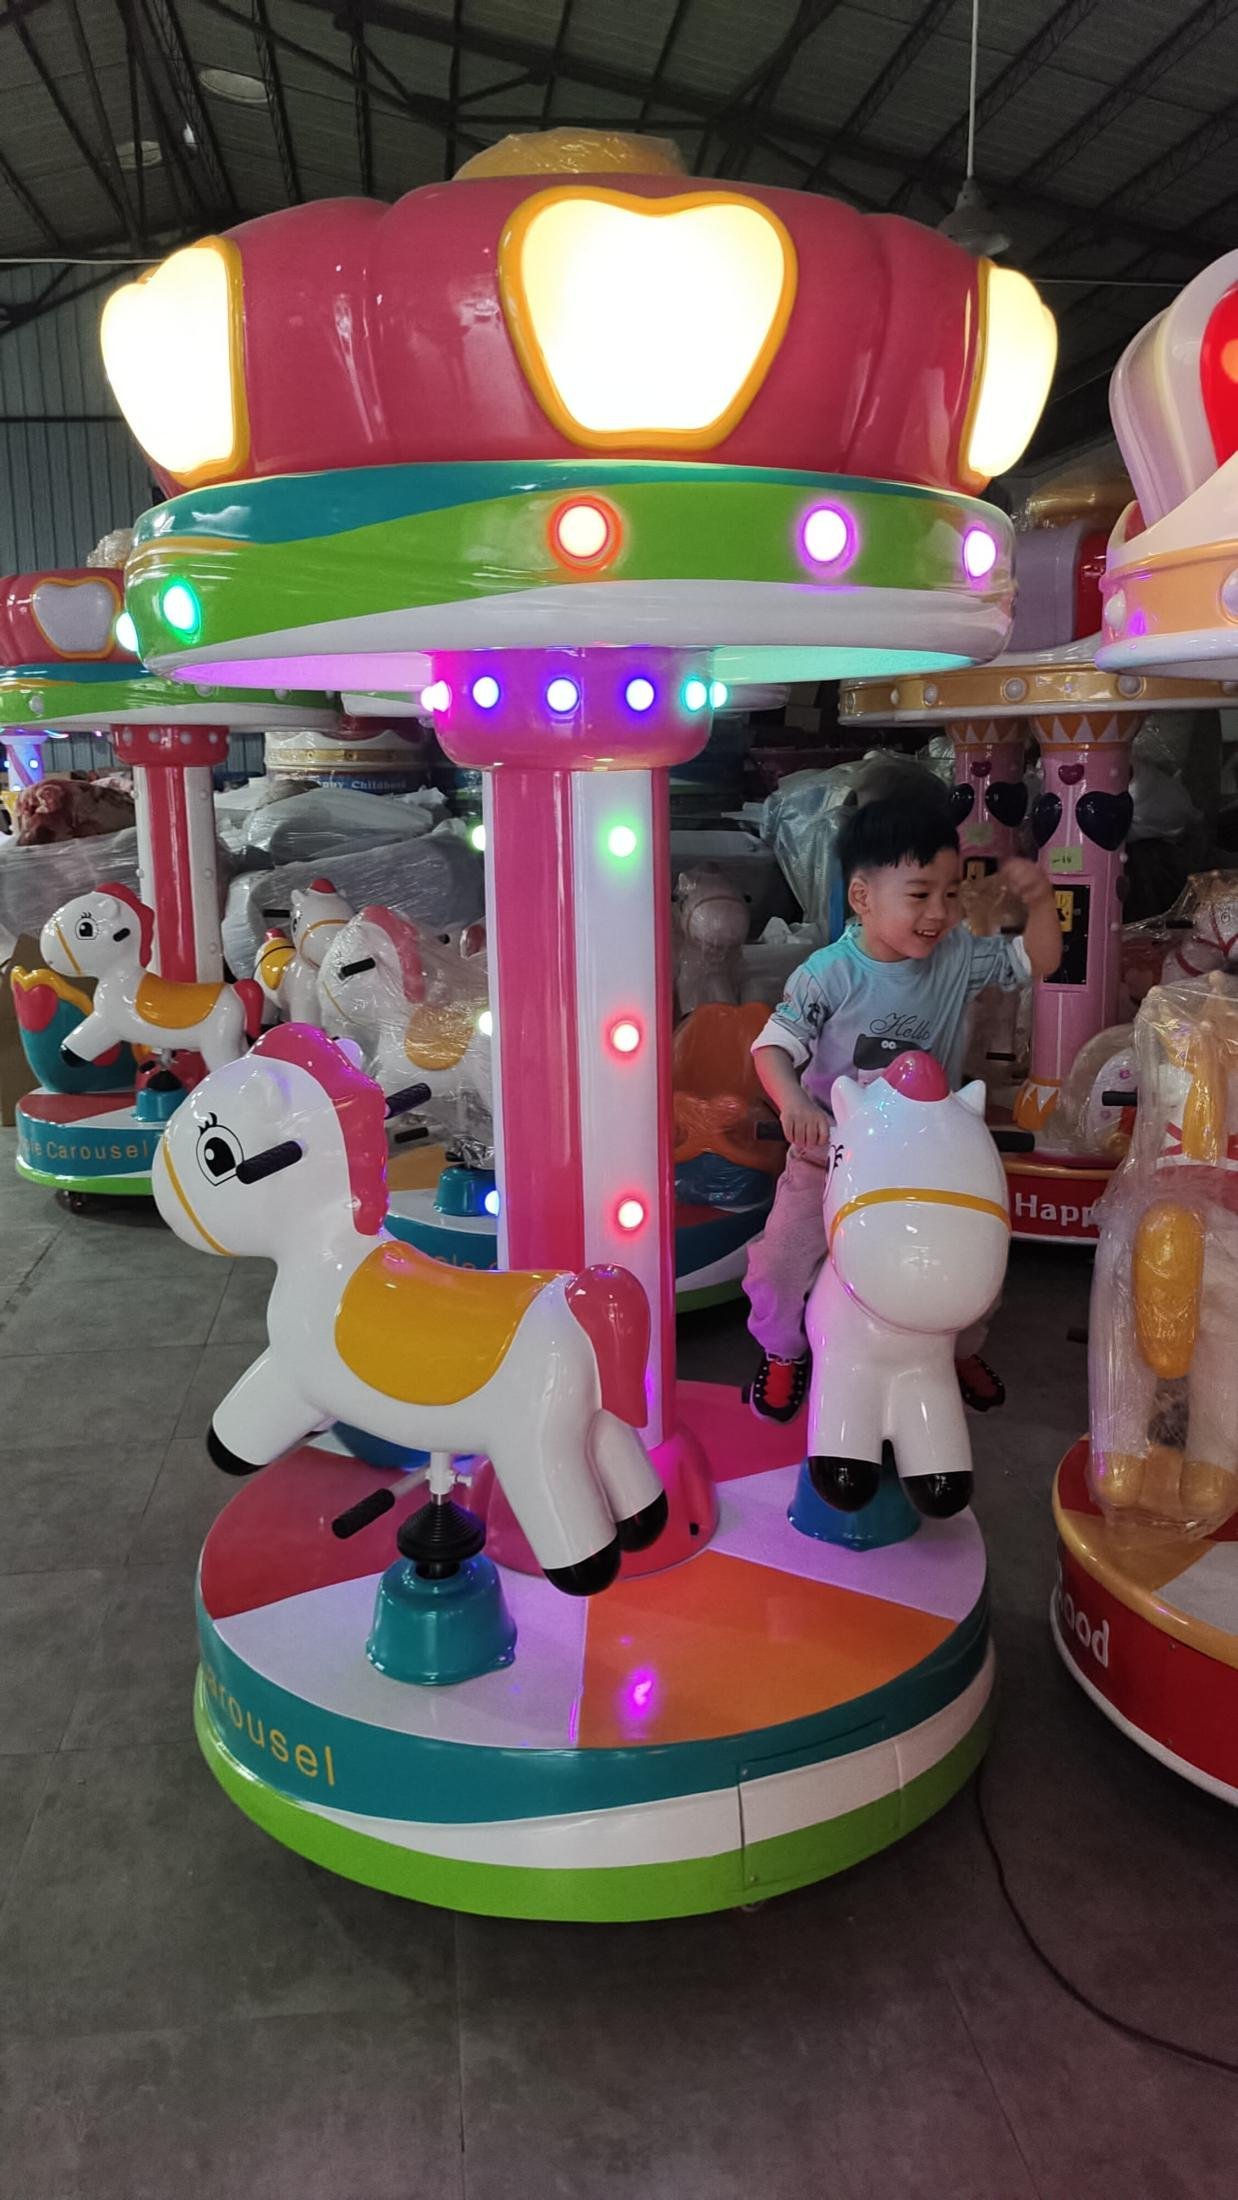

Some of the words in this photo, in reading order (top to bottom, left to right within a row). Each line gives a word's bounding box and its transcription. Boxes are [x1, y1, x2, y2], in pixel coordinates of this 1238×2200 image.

[869, 1012, 930, 1040] Hello
[46, 1139, 149, 1160] Carousel
[1015, 1192, 1098, 1228] Happ
[204, 1664, 335, 1787] arousel
